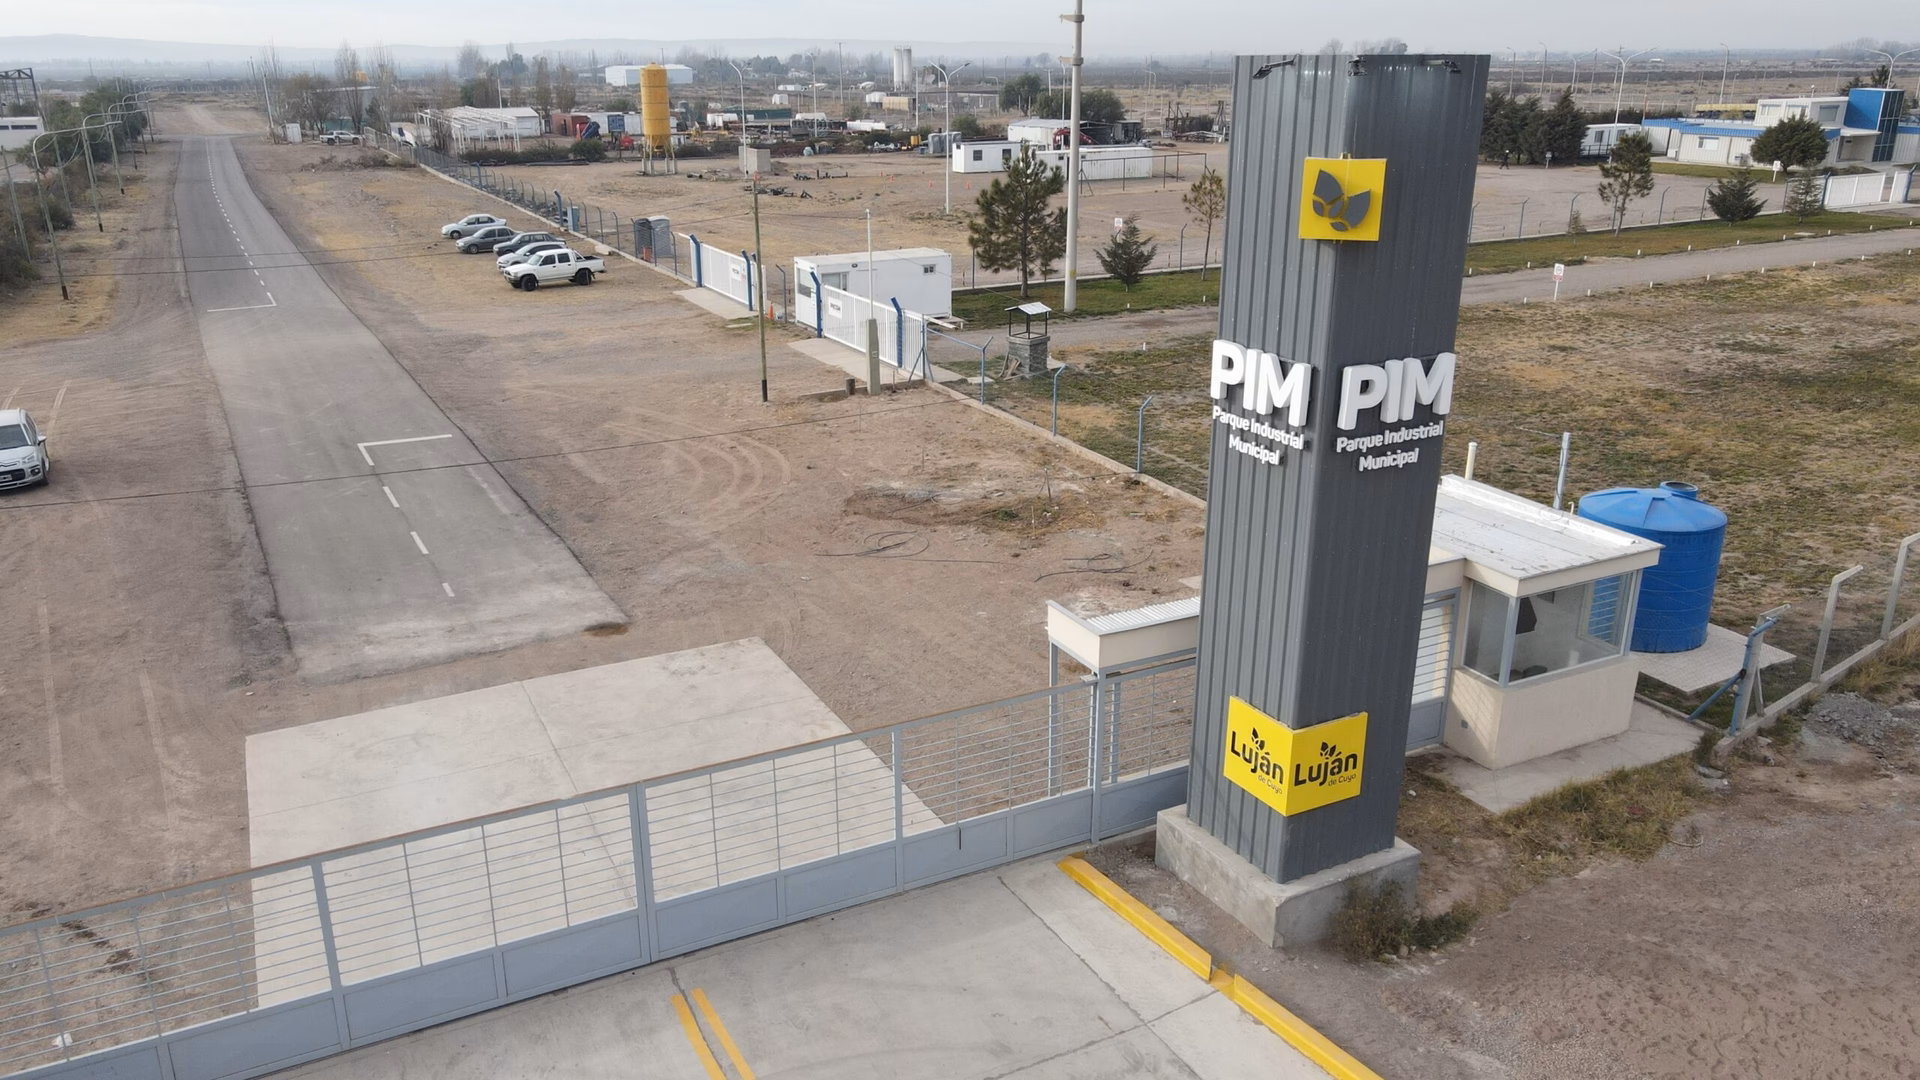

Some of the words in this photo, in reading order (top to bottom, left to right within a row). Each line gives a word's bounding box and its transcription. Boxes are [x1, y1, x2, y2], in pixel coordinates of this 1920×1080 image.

[1210, 339, 1311, 427] PIM
[1337, 351, 1456, 430] PIM
[1212, 405, 1250, 430] Parque
[1250, 418, 1304, 450] Industrial
[1336, 434, 1383, 453] Parque
[1384, 420, 1444, 445] Industrial
[1229, 433, 1280, 465] Municipal
[1358, 447, 1419, 472] Municipal
[1230, 728, 1284, 785] Luján
[1294, 747, 1358, 787] Luján
[1257, 774, 1266, 784] de
[1266, 779, 1283, 795] Cuyo
[1327, 778, 1337, 787] de
[1338, 773, 1357, 785] Cuyo
